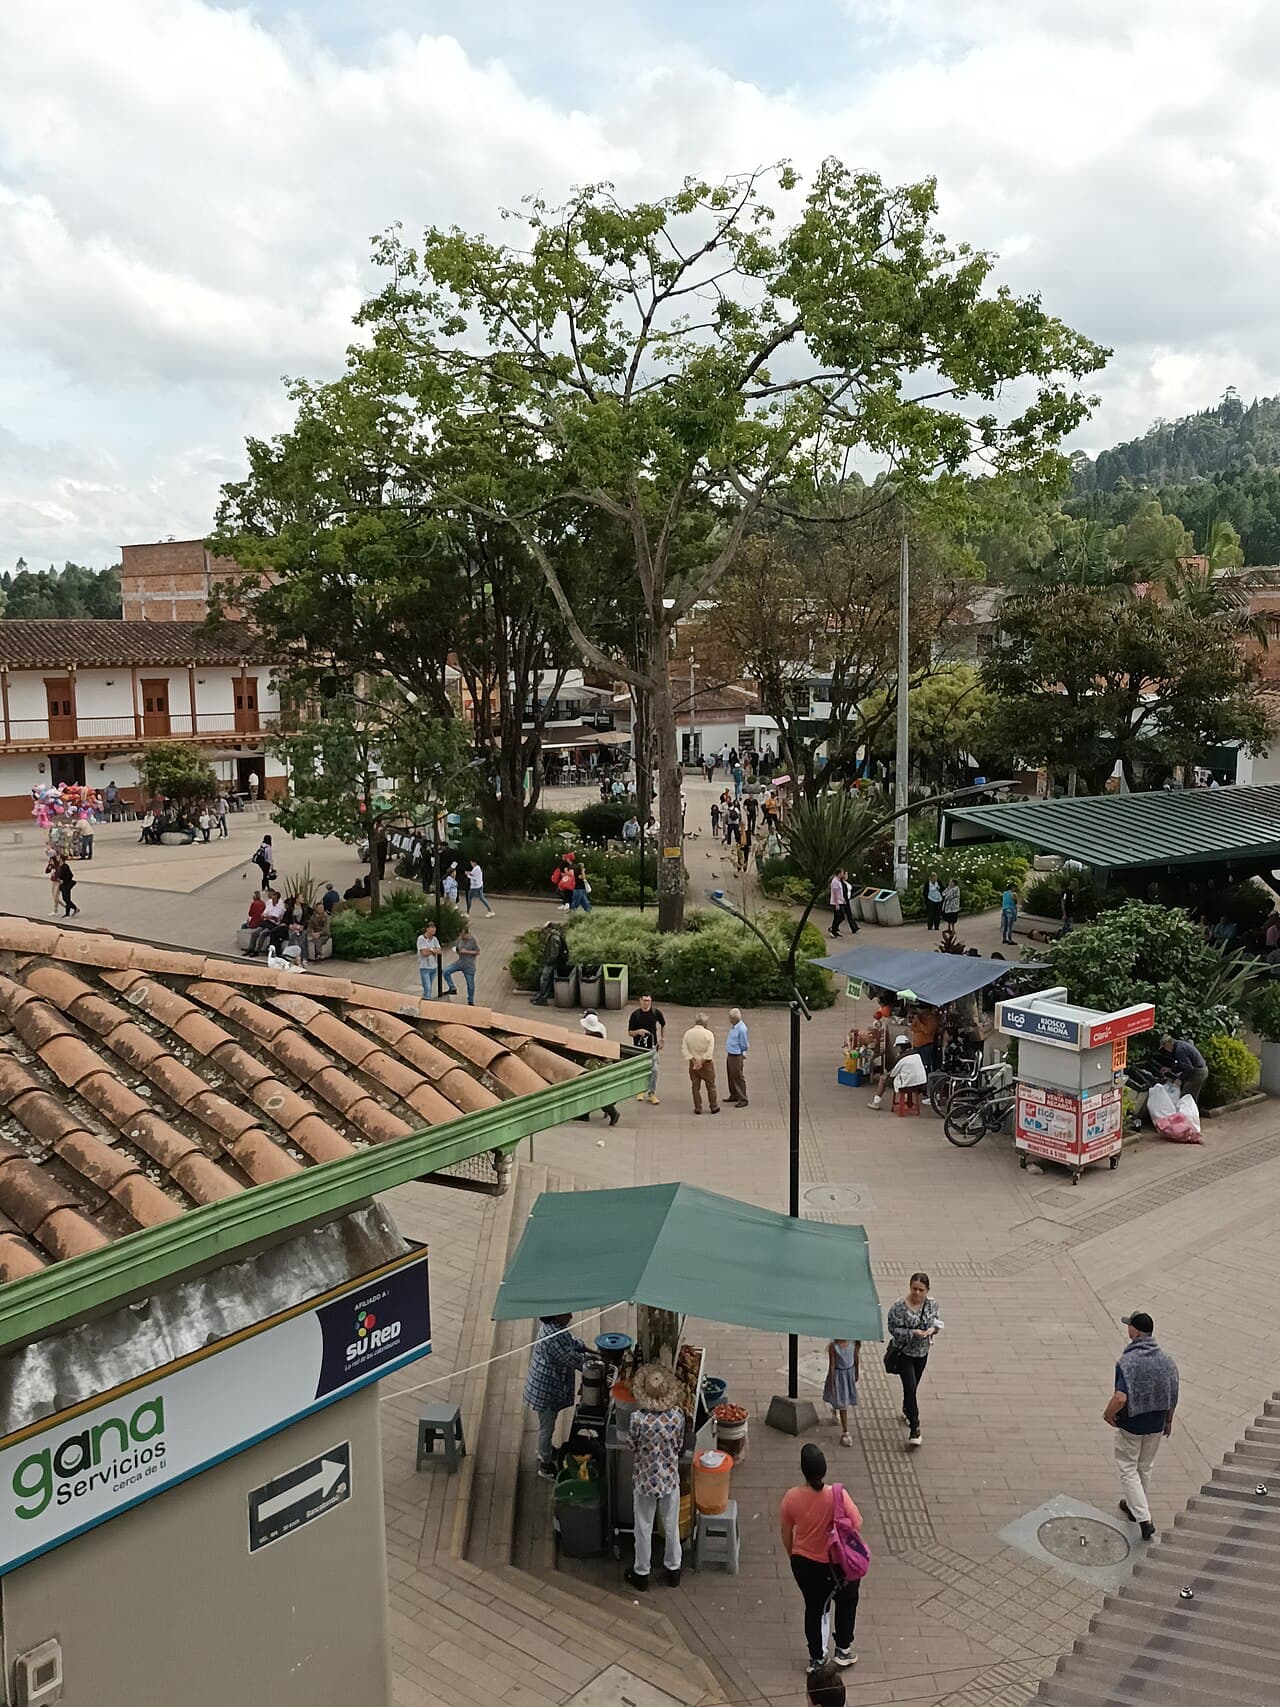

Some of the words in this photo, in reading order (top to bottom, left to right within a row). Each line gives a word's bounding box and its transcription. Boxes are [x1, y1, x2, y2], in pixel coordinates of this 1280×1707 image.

[1038, 1023, 1047, 1031] LA
[1047, 1025, 1069, 1037] MONA
[1040, 1017, 1066, 1029] KIOSCO
[354, 1294, 381, 1310] AFILIADO
[346, 1337, 368, 1361] SU
[12, 1395, 165, 1520] gana
[56, 1442, 167, 1506] Servicios
[112, 1472, 143, 1493] cerca
[144, 1465, 158, 1477] de
[159, 1458, 167, 1473] ti
